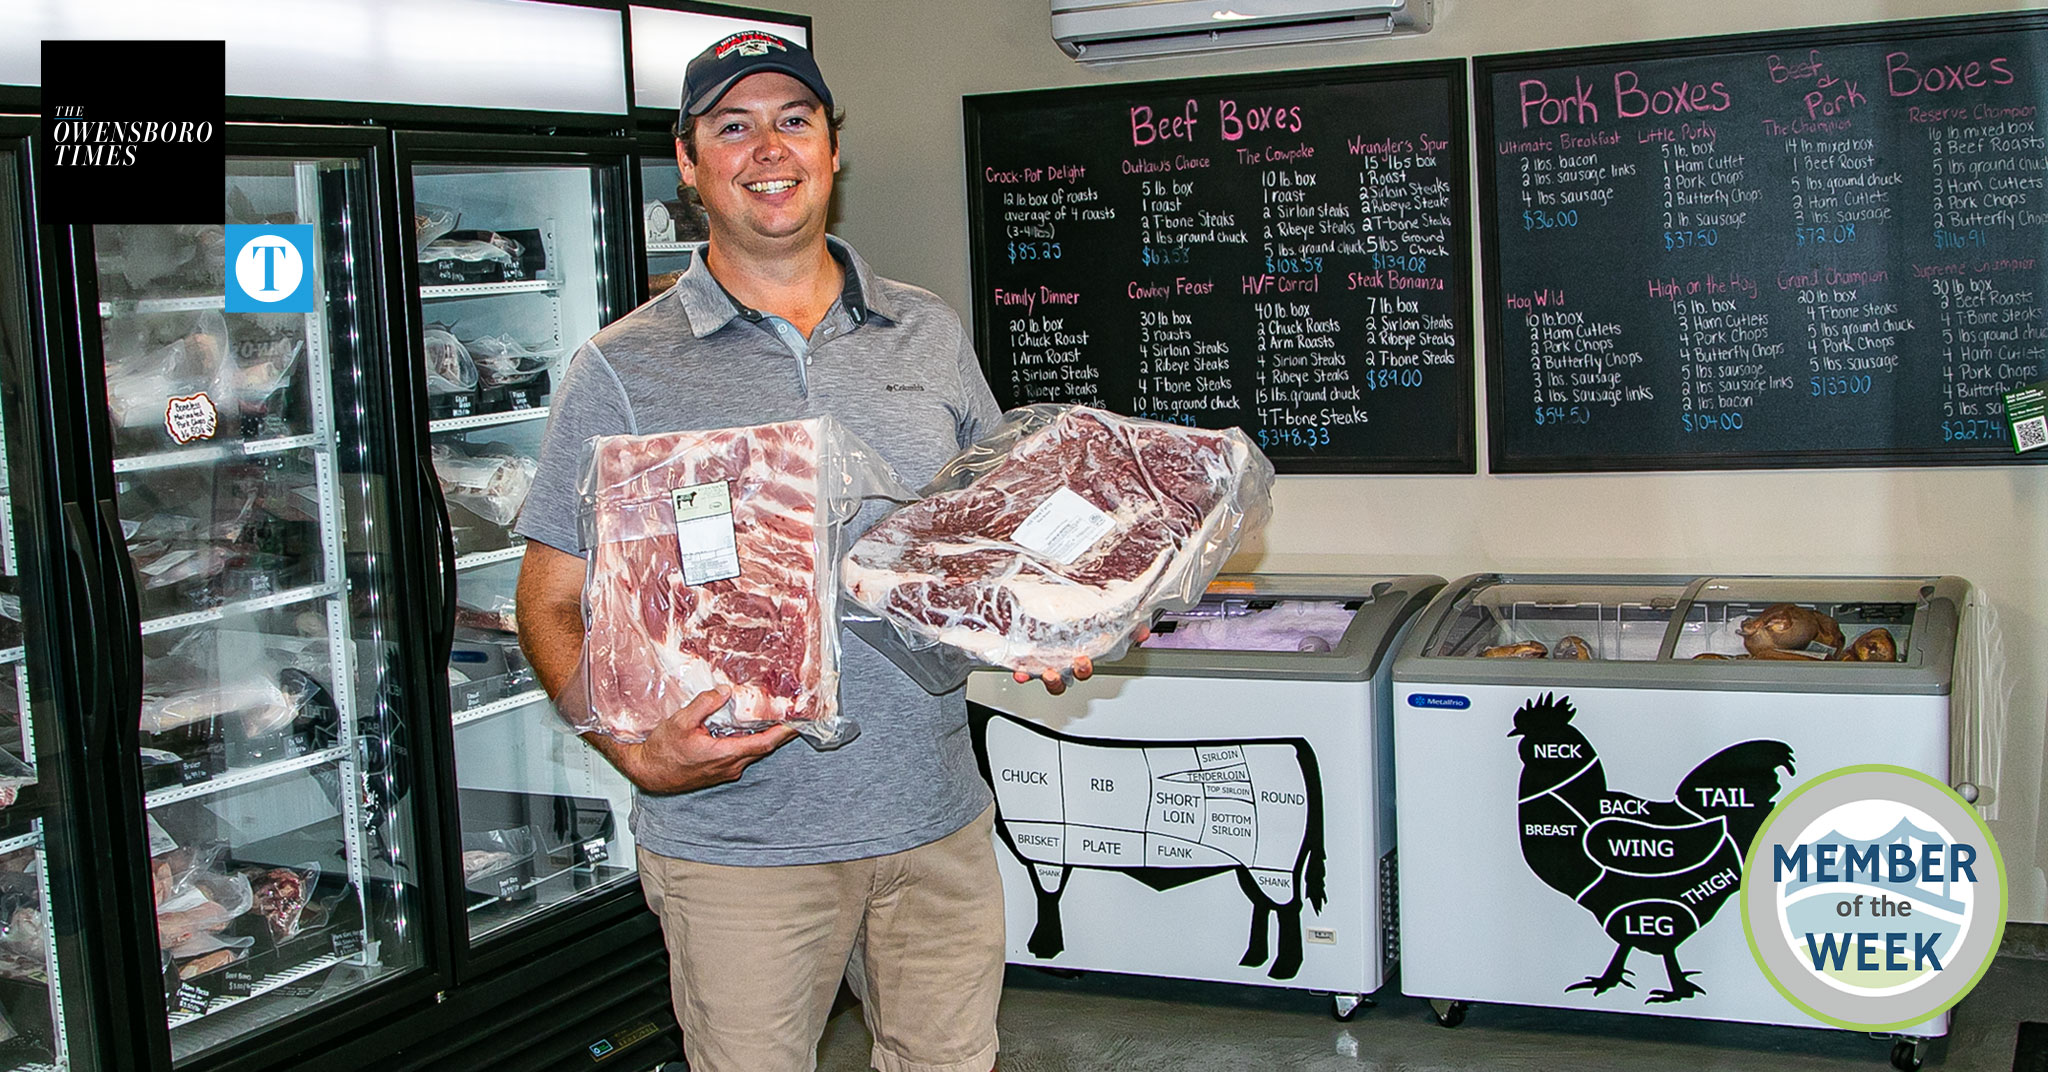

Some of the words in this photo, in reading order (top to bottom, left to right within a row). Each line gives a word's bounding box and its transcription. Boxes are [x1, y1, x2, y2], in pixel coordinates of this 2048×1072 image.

[1767, 50, 1822, 84] Beef
[1886, 51, 2014, 97] Boxes
[1519, 75, 1598, 129] Pork
[1615, 70, 1731, 119] Boxes
[1804, 80, 1867, 119] Pork
[1909, 107, 1968, 123] Reserve
[1974, 103, 2036, 121] Champion
[1131, 99, 1198, 147] Beef
[1220, 100, 1302, 141] Boxes
[1763, 119, 1787, 136] The
[1792, 119, 1852, 137] Champion
[1638, 124, 1675, 144] Little
[1348, 135, 1413, 162] Wrangler's
[1420, 133, 1449, 156] Spur
[1500, 139, 1552, 155] Ultimate
[1560, 132, 1621, 150] Breakfast
[1176, 155, 1210, 170] Choice
[1237, 149, 1260, 164] The
[1266, 143, 1314, 164] Cowpoke
[1365, 157, 1378, 169] 15
[1389, 155, 1411, 169] lbs
[1416, 154, 1436, 167] box
[1521, 158, 1529, 171] 2
[1559, 154, 1598, 168] bacon
[1675, 160, 1704, 173] Ham
[1708, 155, 1745, 170] Cutlet
[1804, 156, 1835, 170] Beef
[1840, 156, 1875, 169] Roast
[986, 167, 1042, 183] Crock-Pot
[1048, 165, 1086, 184] Delight
[1933, 182, 1943, 195] 3
[1947, 179, 1983, 193] Ham
[1989, 177, 2043, 190] Cutlets
[1664, 192, 1672, 209] 2
[1677, 190, 1728, 206] Butterfly
[1731, 188, 1763, 202] Chops
[1005, 210, 1050, 227] average
[1055, 206, 1066, 220] of
[1072, 209, 1078, 221] 4
[1082, 207, 1115, 220] roasts
[1362, 217, 1372, 231] 2
[1372, 216, 1419, 231] T-bone
[1423, 213, 1451, 227] Steaks
[1523, 209, 1578, 231] $36.00
[1264, 228, 1272, 239] 2
[1277, 222, 1314, 240] Ribeye
[1321, 221, 1355, 235] Steaks
[1795, 223, 1856, 247] $72.08
[1664, 229, 1718, 251] $37.50
[1008, 241, 1062, 264] $85.25
[1373, 254, 1426, 273] $139.08
[1176, 277, 1214, 295] Feast
[1242, 274, 1275, 294] HVF
[1279, 274, 1319, 292] Corral
[1348, 272, 1384, 291] Steak
[1388, 270, 1444, 291] Bonanza
[1649, 278, 1681, 301] High
[1686, 281, 1701, 294] on
[1706, 274, 1726, 293] the
[1777, 270, 1819, 289] Grand
[1826, 268, 1888, 285] Champion
[995, 288, 1036, 316] Family
[1040, 286, 1080, 305] Dinner
[1507, 293, 1532, 315] Hog
[1534, 289, 1564, 306] Wild
[1258, 324, 1265, 335] 2
[1269, 320, 1303, 335] Chuck
[1306, 318, 1340, 333] Roasts
[1531, 328, 1539, 340] 2
[1544, 328, 1574, 340] Ham
[1576, 323, 1622, 338] Cutlets
[1019, 333, 1051, 347] Chuck
[1055, 331, 1089, 345] Roast
[1258, 340, 1266, 351] 2
[1270, 336, 1293, 349] Arm
[1298, 335, 1335, 348] Roasts
[1366, 351, 1375, 365] 2
[1379, 350, 1419, 366] T-bone
[1423, 350, 1455, 365] Steaks
[1532, 357, 1540, 370] 2
[1545, 355, 1602, 373] Butterfly
[1606, 352, 1642, 366] Chops
[1257, 372, 1265, 384] 4
[1272, 370, 1308, 387] Ribeye
[1314, 369, 1349, 383] Steaks
[1367, 369, 1423, 390] $89.00
[1943, 367, 1954, 382] 4
[1960, 364, 1992, 379] Pork
[1999, 364, 2038, 379] Chops
[1256, 389, 1268, 404] 15
[1290, 387, 1327, 409] ground
[1330, 385, 1360, 400] chuck
[1258, 408, 1268, 425] 4
[1270, 408, 1318, 426] T-bone
[1321, 406, 1368, 425] Steaks
[1258, 428, 1330, 450] $348.33
[1427, 698, 1464, 706] Metalfrio
[1202, 750, 1239, 763] SIRLOIN
[1534, 744, 1582, 759] NECK
[1002, 769, 1048, 786] CHUCK
[1187, 770, 1246, 782] TENDERLOIN
[1090, 778, 1114, 793] RIB
[1207, 786, 1221, 794] TOP
[1223, 786, 1250, 796] SIRLOIN
[1156, 793, 1201, 808] SHORT
[1261, 792, 1305, 806] ROUND
[1696, 787, 1754, 808] TAIL
[1600, 800, 1650, 815] BACK
[1163, 810, 1195, 825] LOIN
[1212, 813, 1251, 826] BOTTOM
[1212, 825, 1251, 838] SIRLOIN
[1525, 824, 1577, 836] BREAST
[1017, 834, 1060, 848] BRISKET
[1083, 840, 1122, 855] PLATE
[1608, 838, 1675, 857] WING
[1157, 845, 1193, 859] FLANK
[1038, 869, 1061, 878] SHANK
[1259, 875, 1291, 889] SHANK
[1681, 867, 1739, 906] THIGH
[1625, 915, 1674, 935] LEG
